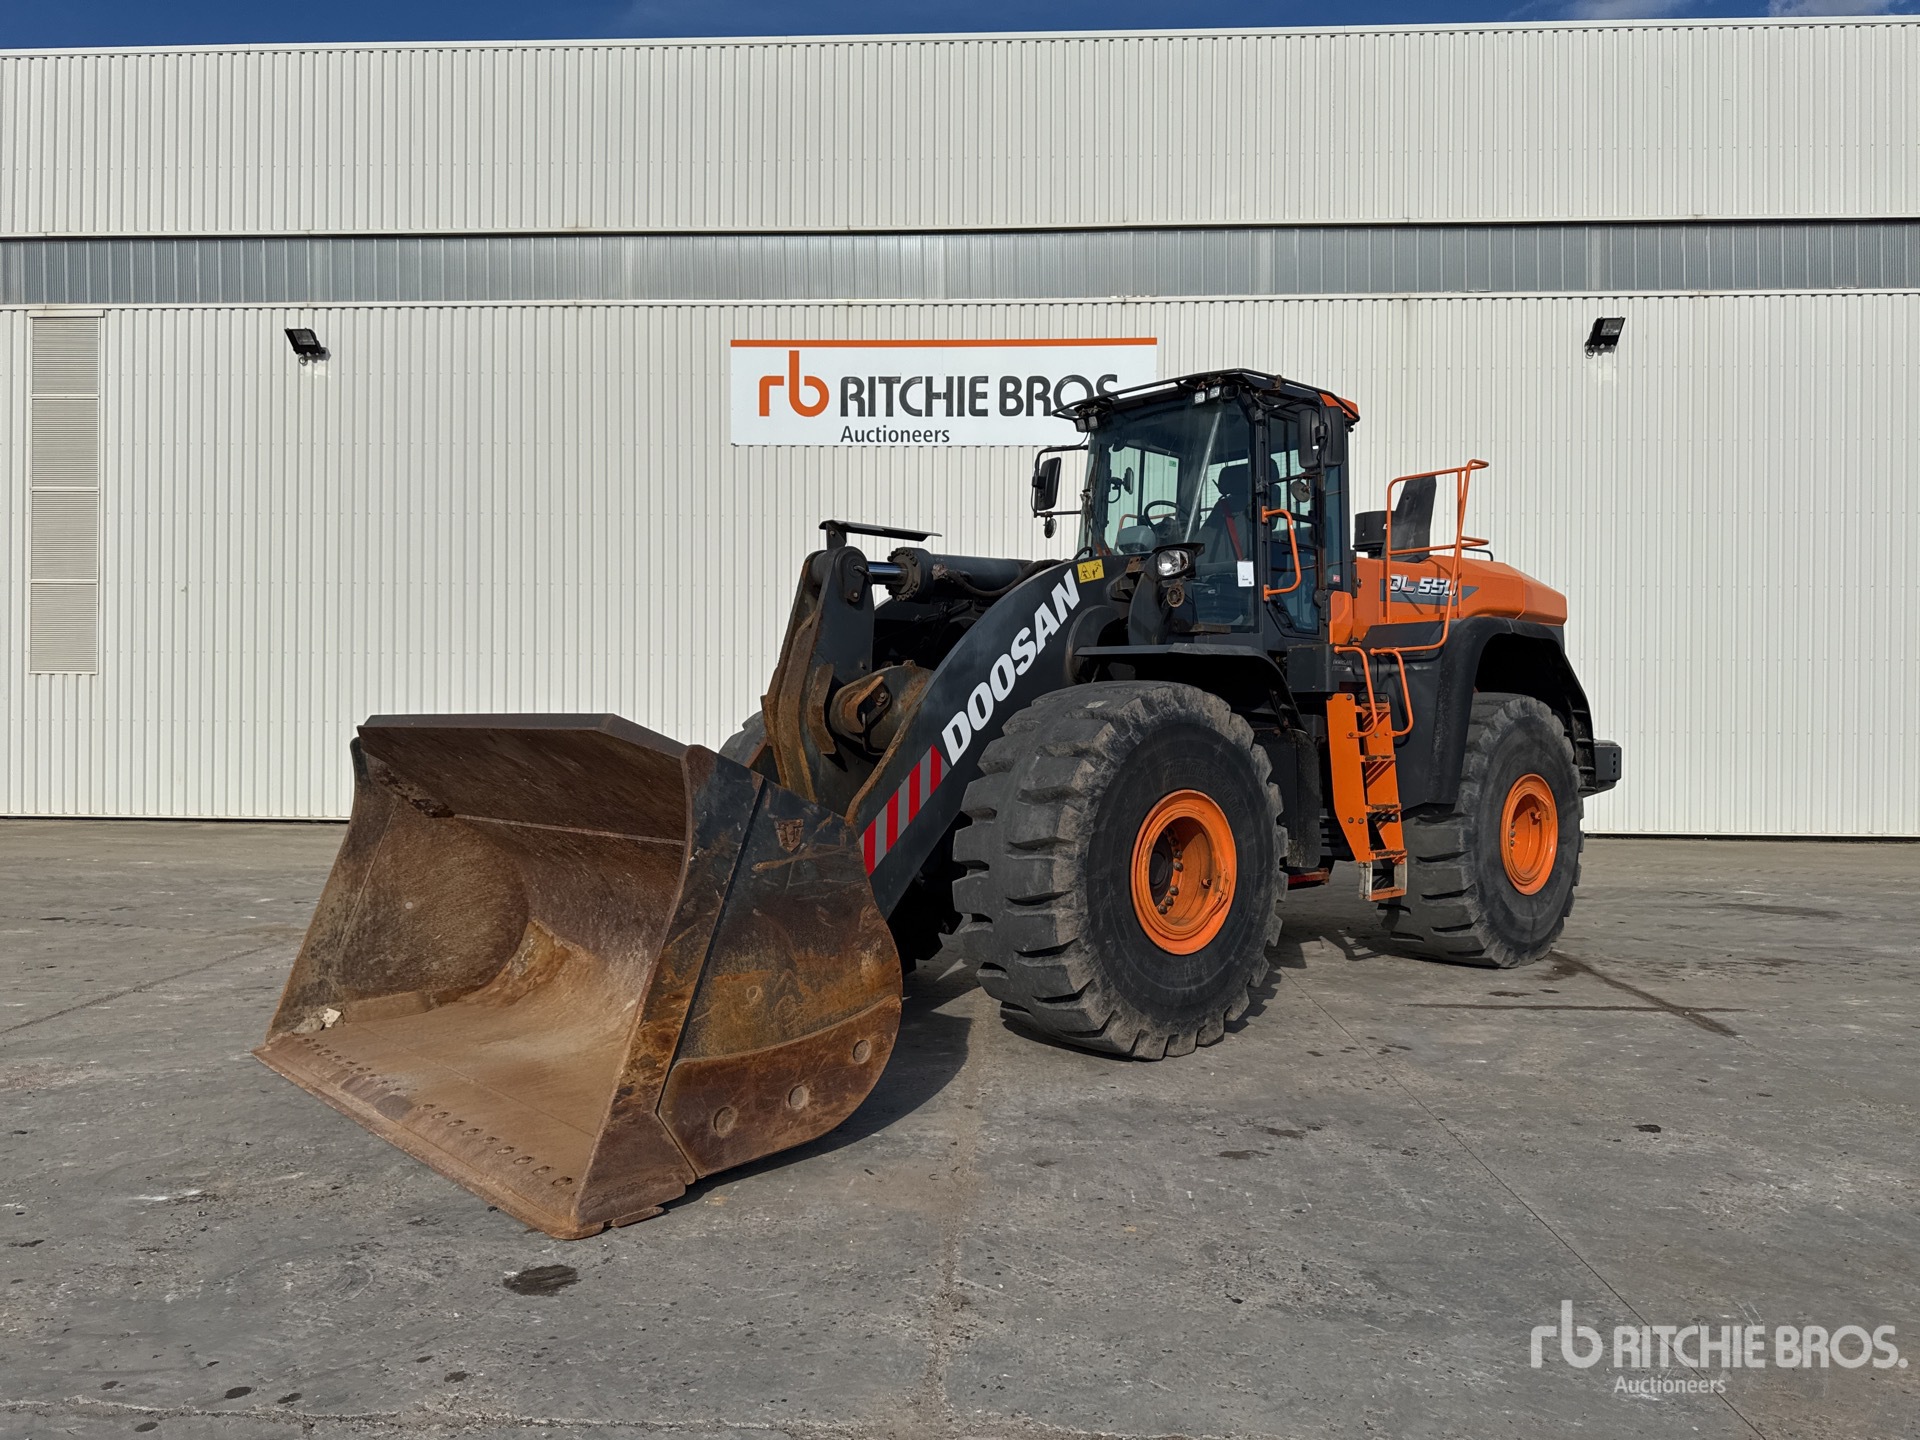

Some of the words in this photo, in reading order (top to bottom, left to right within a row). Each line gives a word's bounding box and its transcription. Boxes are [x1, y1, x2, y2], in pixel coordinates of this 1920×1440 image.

[759, 350, 829, 417] rb
[840, 375, 989, 417] RITCHIE
[840, 425, 950, 443] Auctioneers
[941, 568, 1080, 766] DOOSAN
